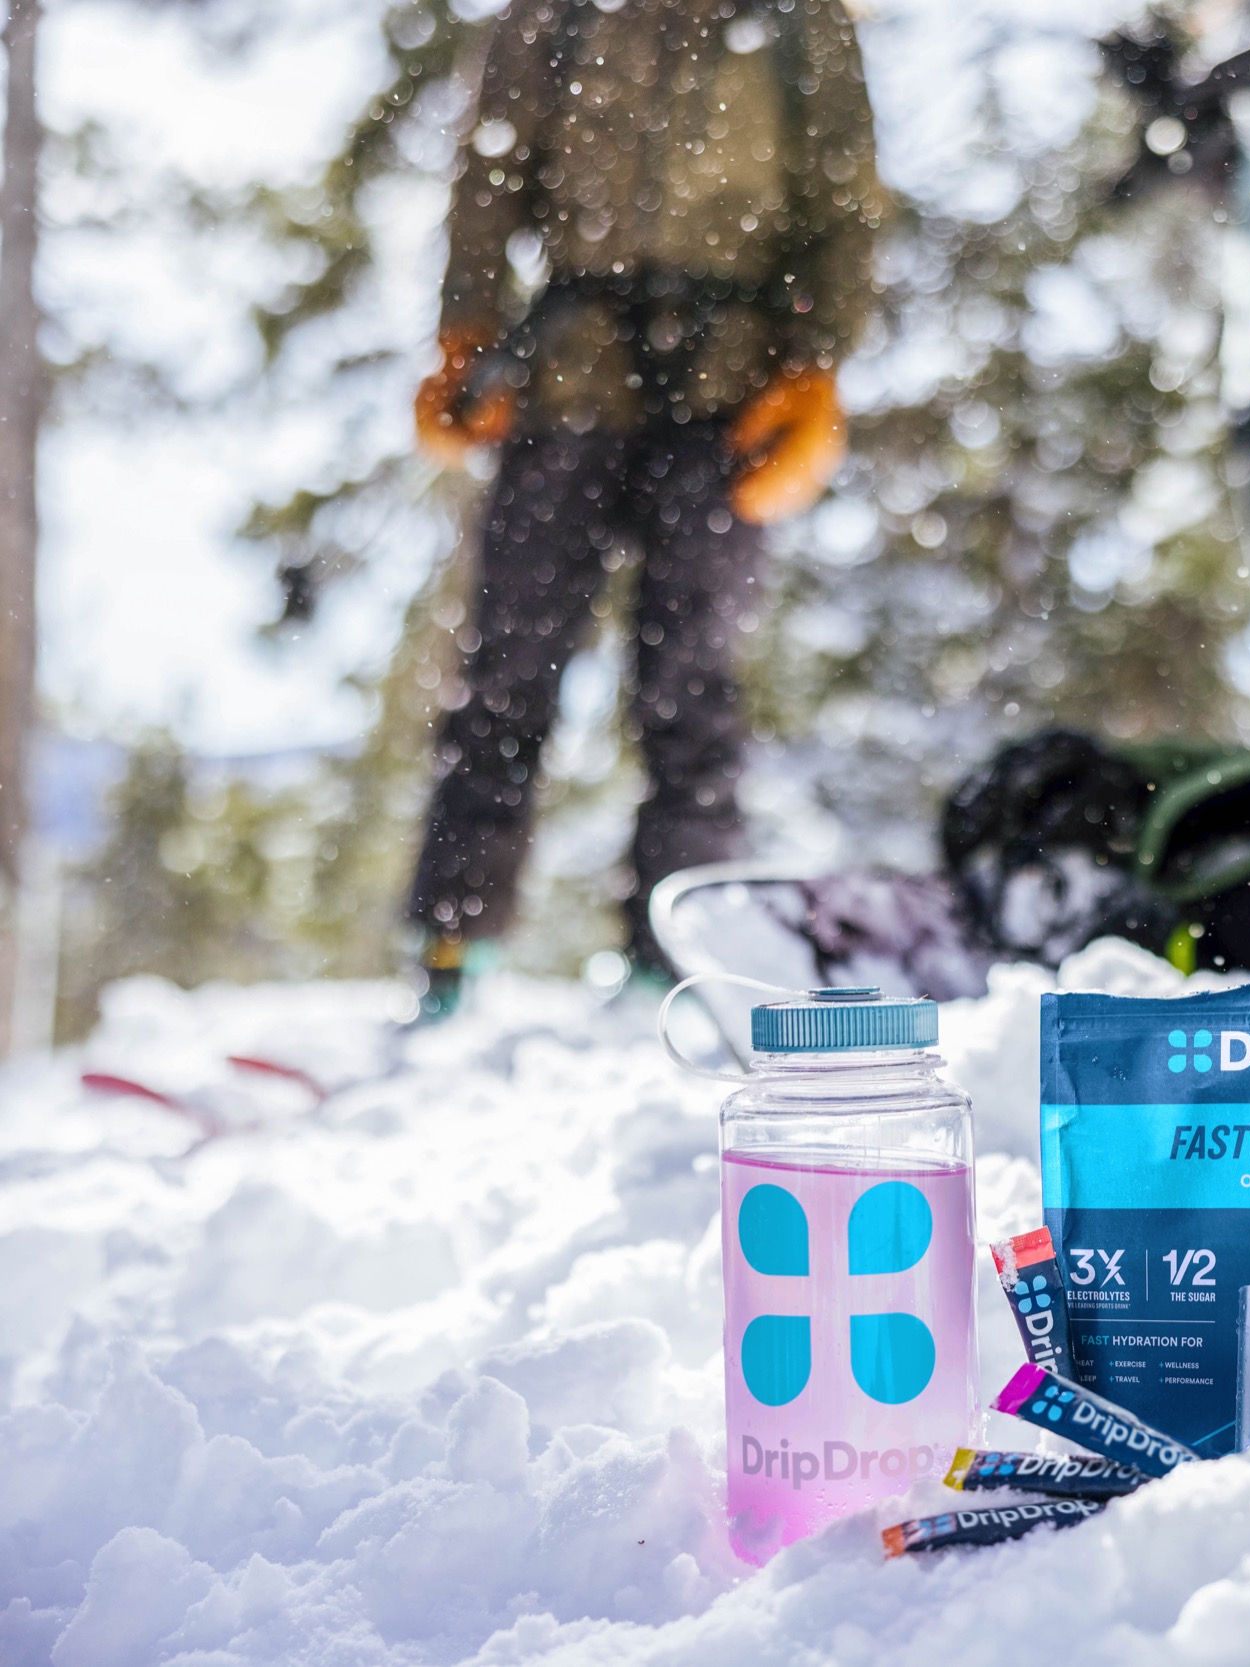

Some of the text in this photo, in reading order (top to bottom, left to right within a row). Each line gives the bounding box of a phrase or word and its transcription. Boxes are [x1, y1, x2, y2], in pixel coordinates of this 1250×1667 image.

[1070, 1249, 1126, 1288] 3X
[1162, 1249, 1217, 1286] 1/2
[1067, 1291, 1130, 1301] ELECTROLYTES
[1170, 1292, 1216, 1302] THE SUGAR
[1081, 1335, 1203, 1347] FAST HYDRATION FOR
[1165, 1377, 1214, 1385] PERFORMANCE
